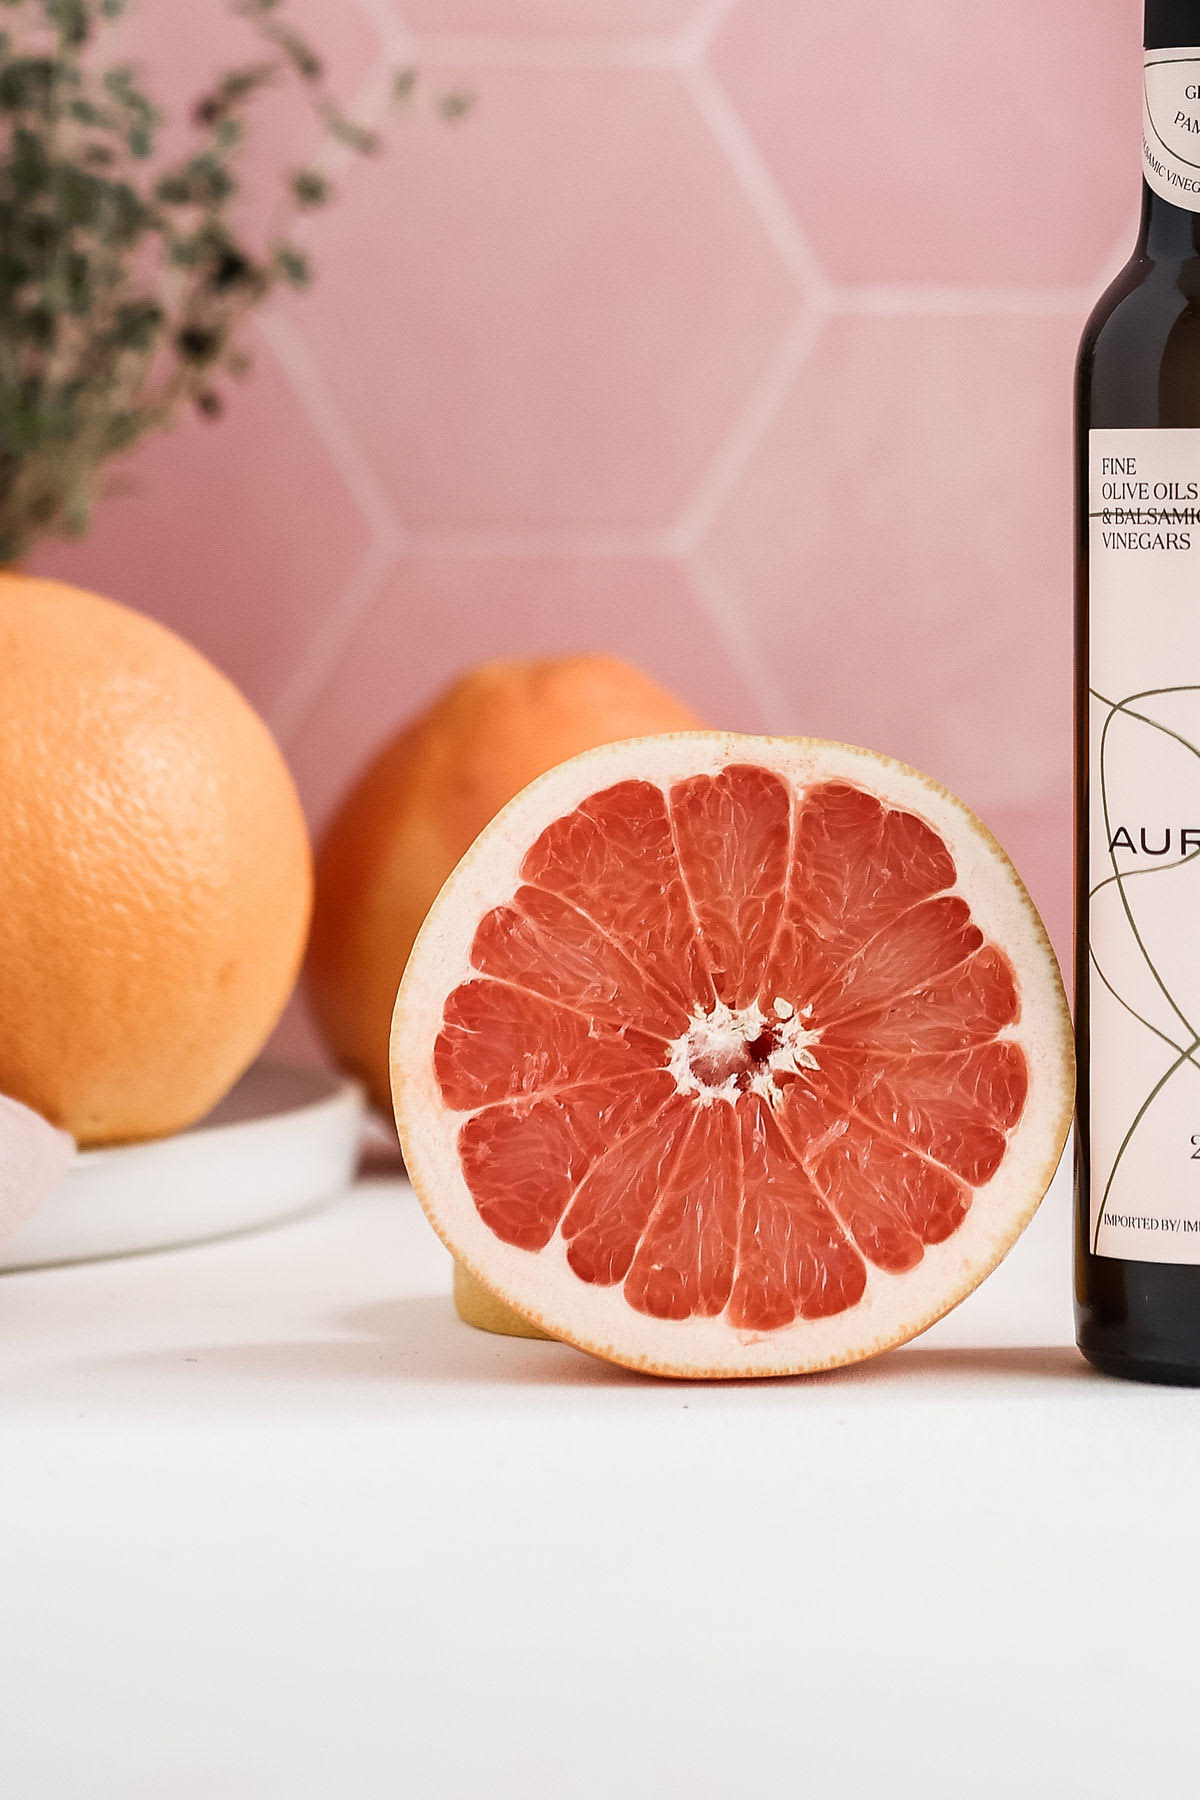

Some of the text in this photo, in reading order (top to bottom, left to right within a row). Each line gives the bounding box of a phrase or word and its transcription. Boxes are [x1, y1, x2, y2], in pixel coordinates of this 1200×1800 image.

[1101, 457, 1137, 476] FINE
[1101, 482, 1199, 501] OLIVE OILS
[1101, 531, 1192, 550] VINEGARS
[1103, 1212, 1160, 1231] IMPORTED
